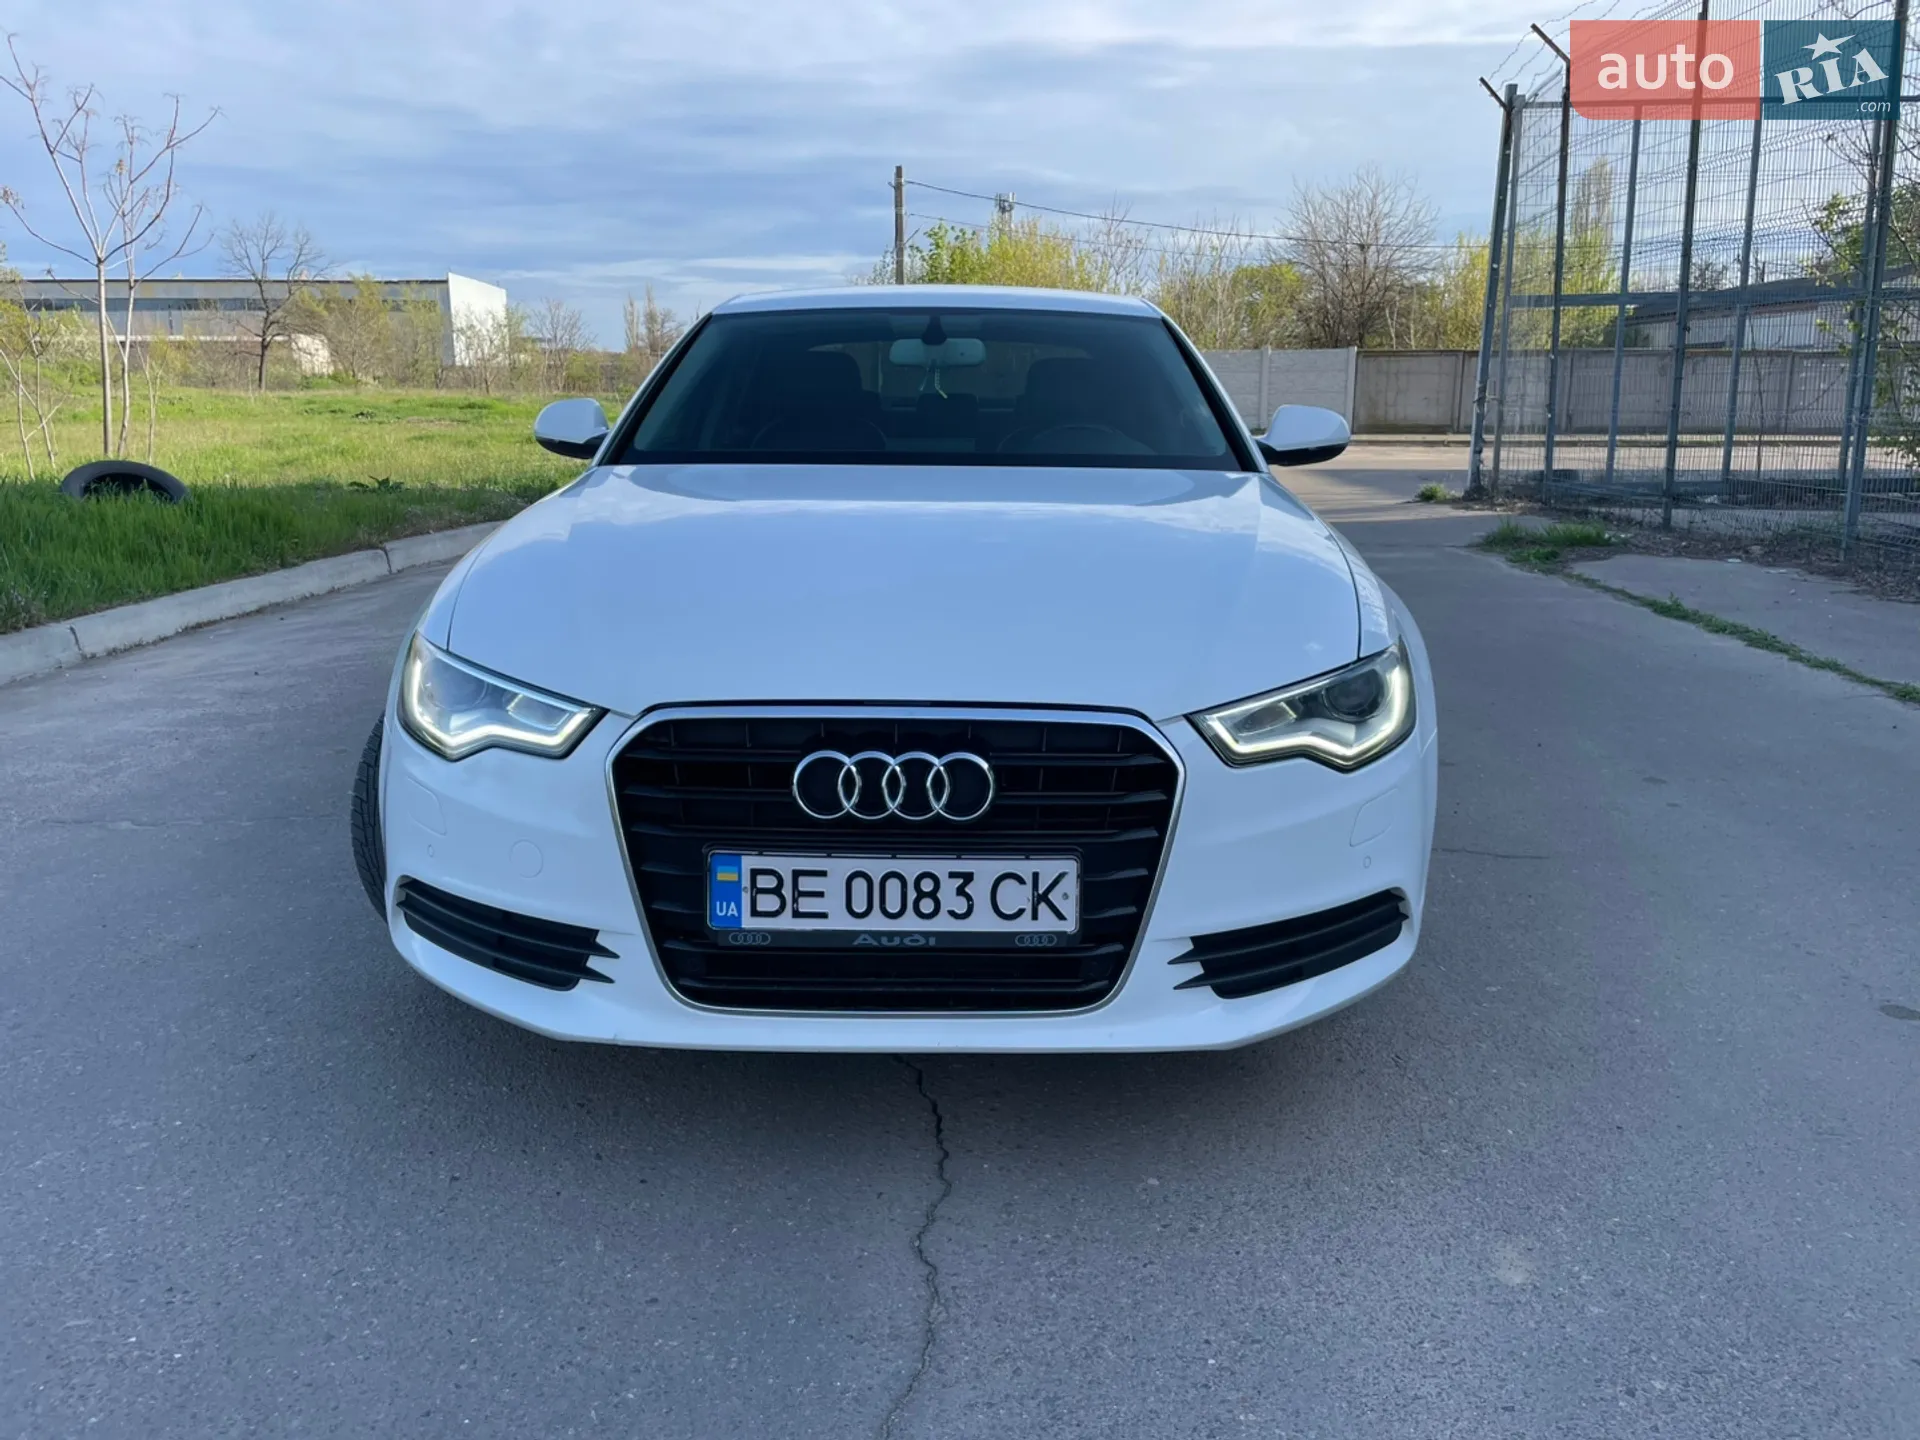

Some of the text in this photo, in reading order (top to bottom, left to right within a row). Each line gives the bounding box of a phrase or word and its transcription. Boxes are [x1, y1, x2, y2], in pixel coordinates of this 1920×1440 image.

[716, 901, 739, 918] UA
[749, 868, 1069, 921] BE 0083 CK
